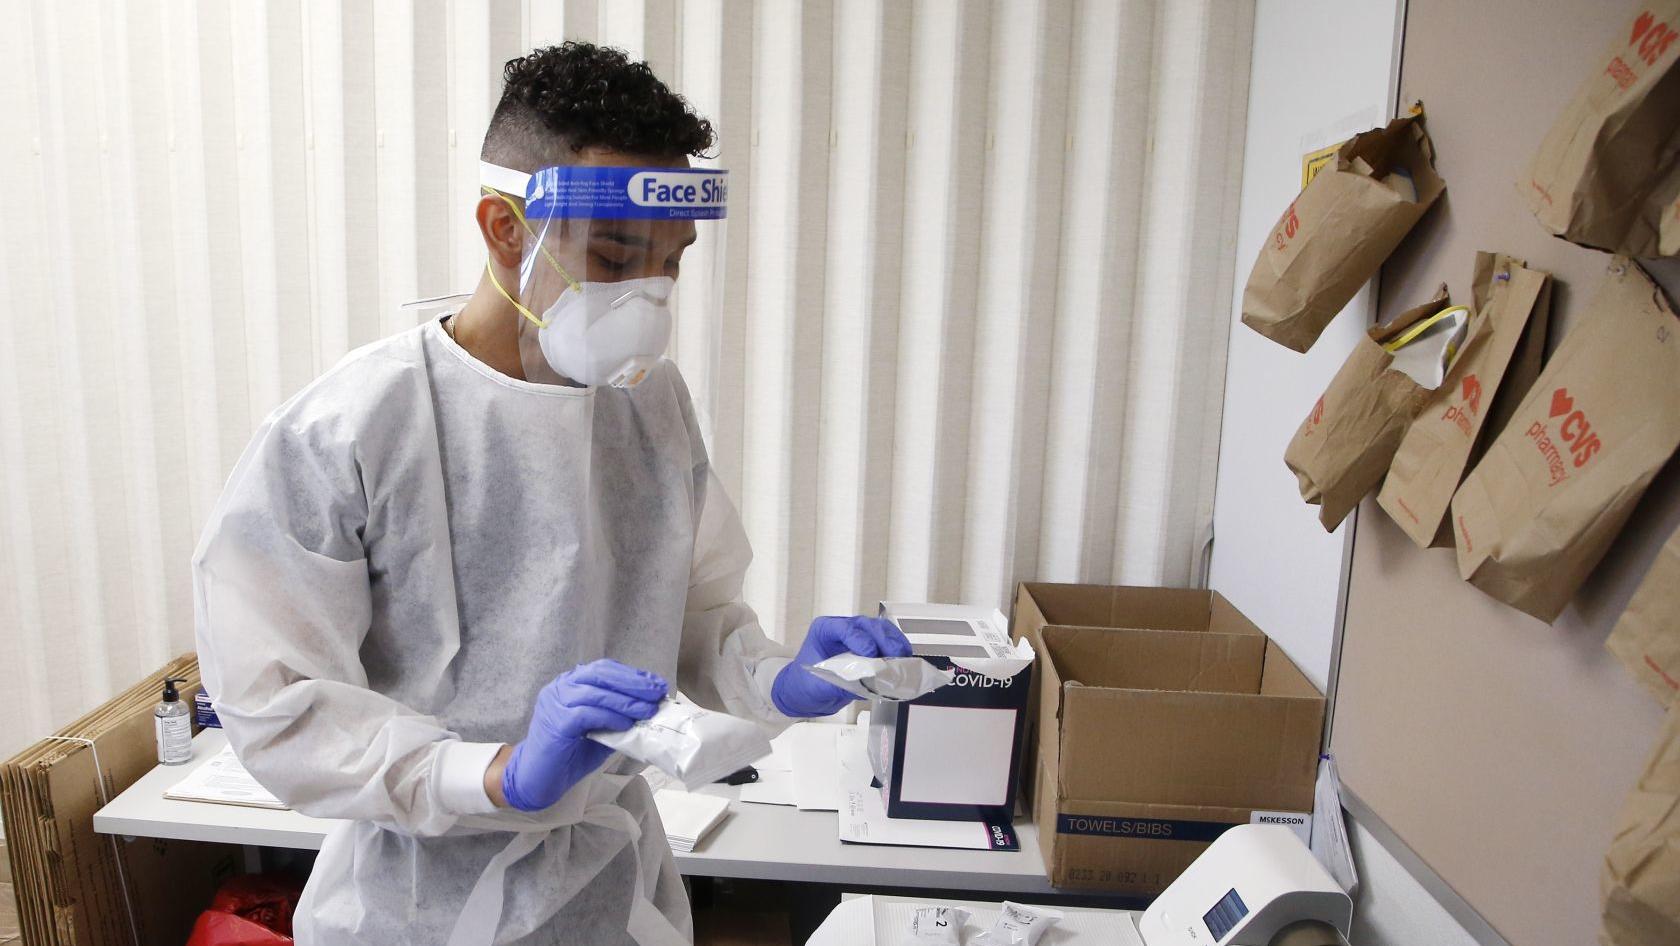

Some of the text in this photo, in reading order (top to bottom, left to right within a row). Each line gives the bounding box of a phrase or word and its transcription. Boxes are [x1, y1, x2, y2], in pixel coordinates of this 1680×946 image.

[643, 178, 696, 203] Face
[1525, 421, 1570, 487] pharmacy
[1561, 411, 1601, 468] CVS
[1067, 818, 1173, 836] TOWELS/BIBS
